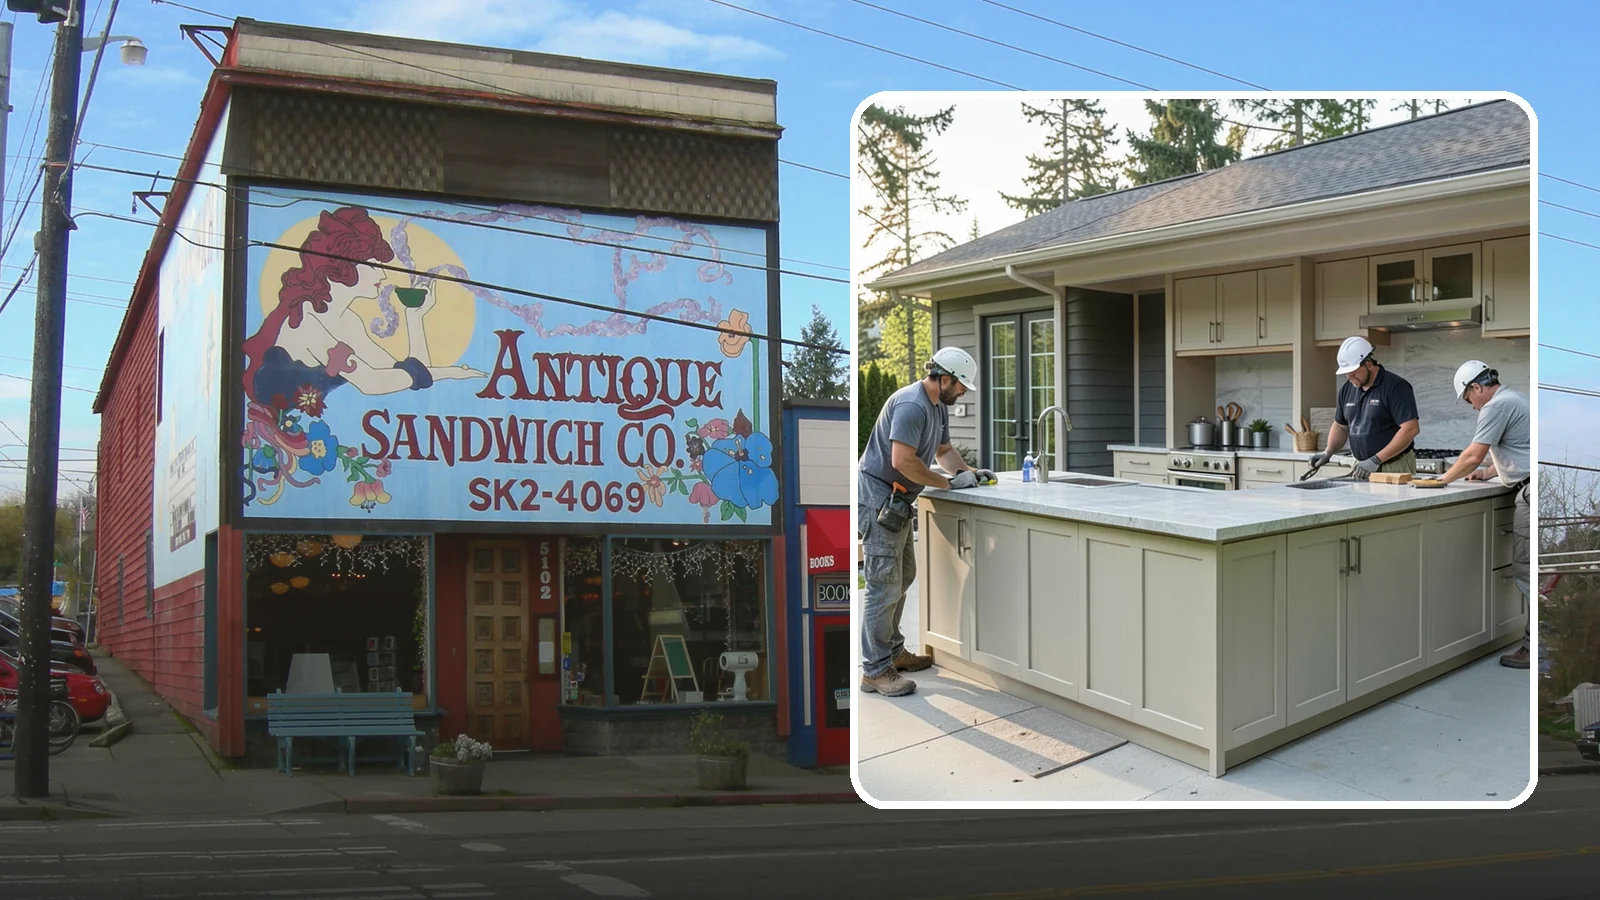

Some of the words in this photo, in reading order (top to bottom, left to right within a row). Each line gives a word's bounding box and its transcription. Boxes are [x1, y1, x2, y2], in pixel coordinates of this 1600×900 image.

[477, 329, 722, 419] ANTIQUE
[361, 409, 605, 467] SANDWICH
[616, 422, 686, 469] CO.
[468, 478, 646, 512] SK2-4069
[539, 541, 555, 599] 5102
[809, 555, 835, 569] BOOKS
